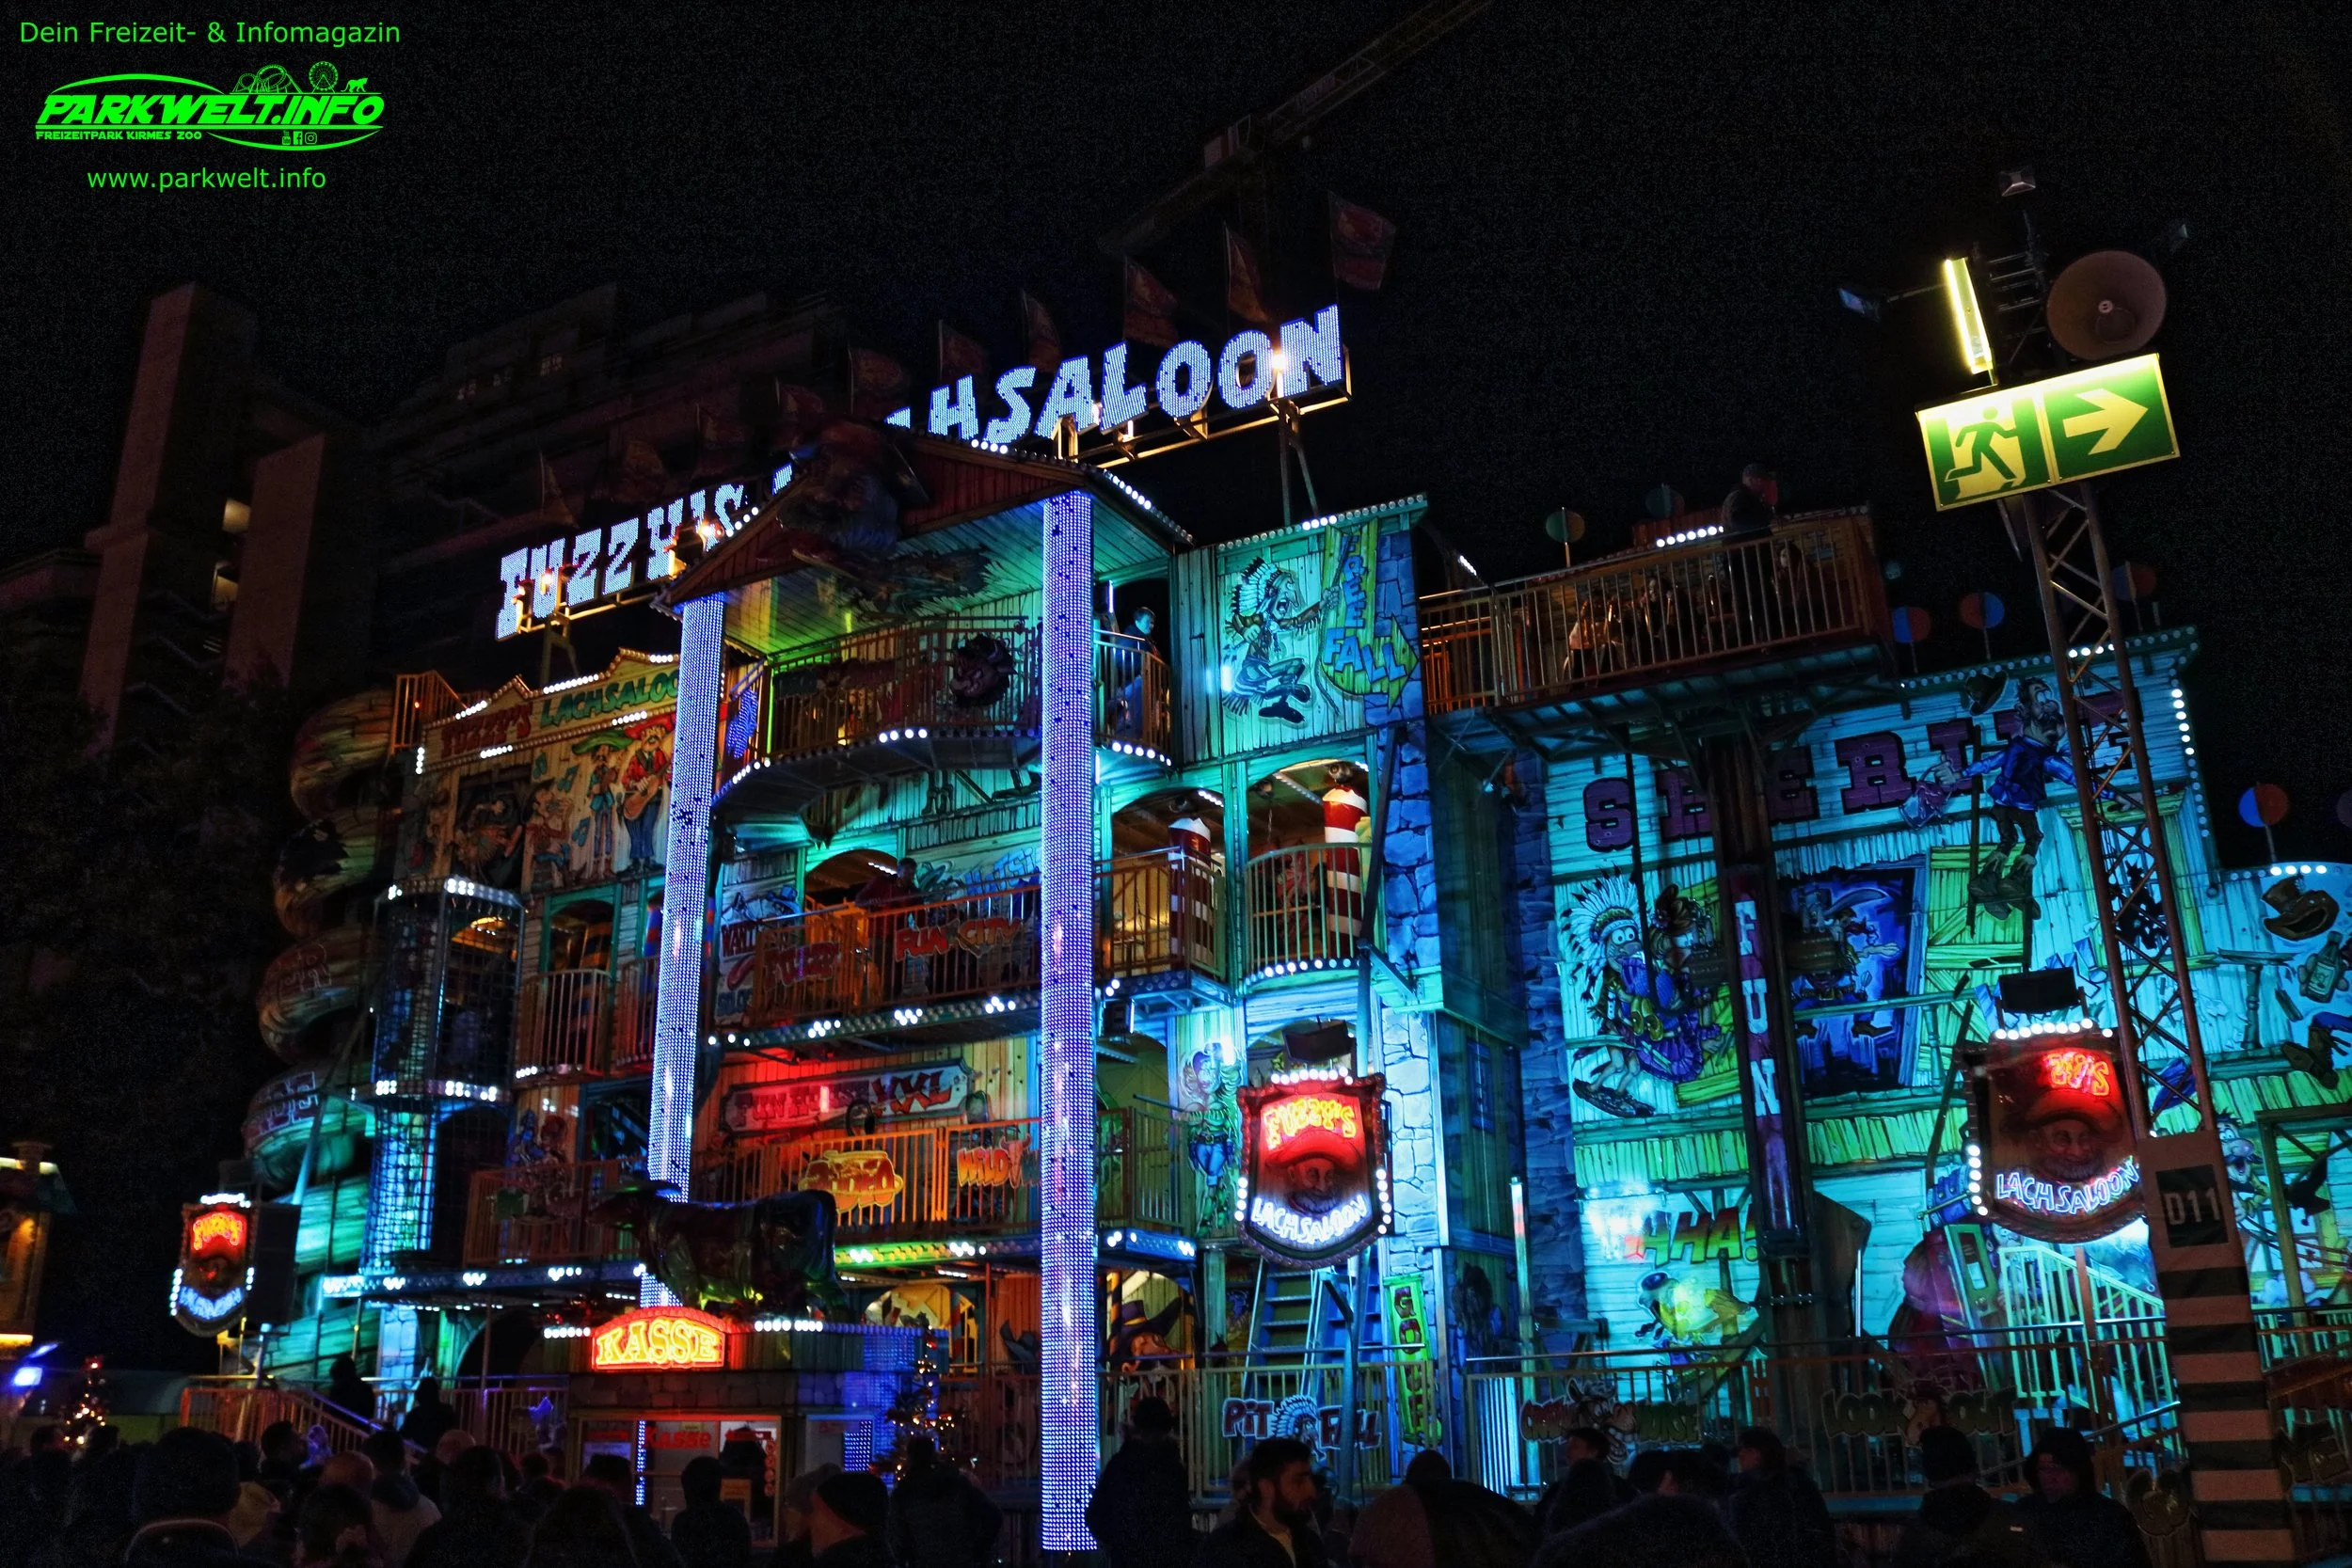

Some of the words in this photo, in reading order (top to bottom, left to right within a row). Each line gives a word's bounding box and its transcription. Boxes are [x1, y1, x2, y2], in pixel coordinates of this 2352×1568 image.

[1340, 533, 1367, 629] FREE
[1324, 626, 1408, 684] FALL
[1735, 899, 1783, 1117] FUN
[870, 1069, 953, 1117] XXL
[1263, 1097, 1357, 1150] FUZZY'S
[1995, 1156, 2140, 1215] LACHSALOON
[2166, 1187, 2222, 1226] D11
[1251, 1195, 1369, 1244] LACHSALOON
[596, 1316, 722, 1365] KASSE
